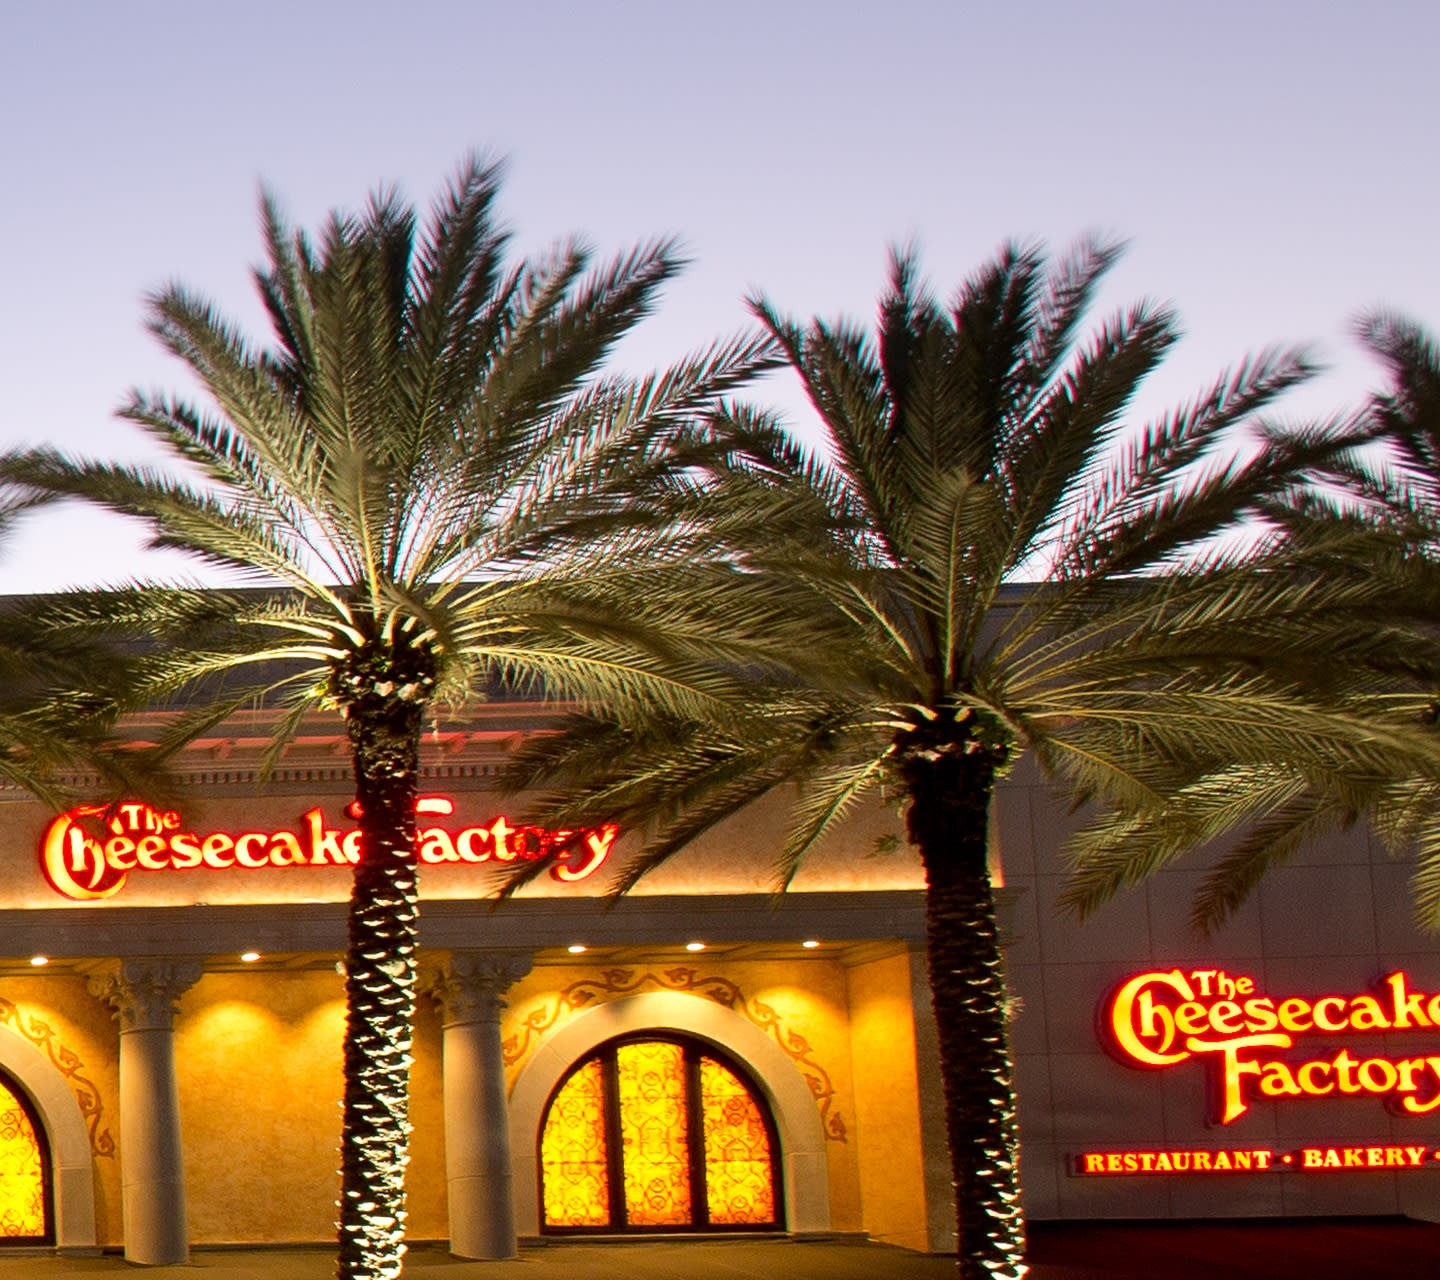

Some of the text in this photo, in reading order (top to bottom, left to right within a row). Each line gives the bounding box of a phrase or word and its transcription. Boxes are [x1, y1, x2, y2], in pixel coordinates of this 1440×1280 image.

[120, 803, 181, 834] The
[1191, 970, 1256, 1000] The
[1084, 1146, 1426, 1174] RESTAURANT BAKERY
